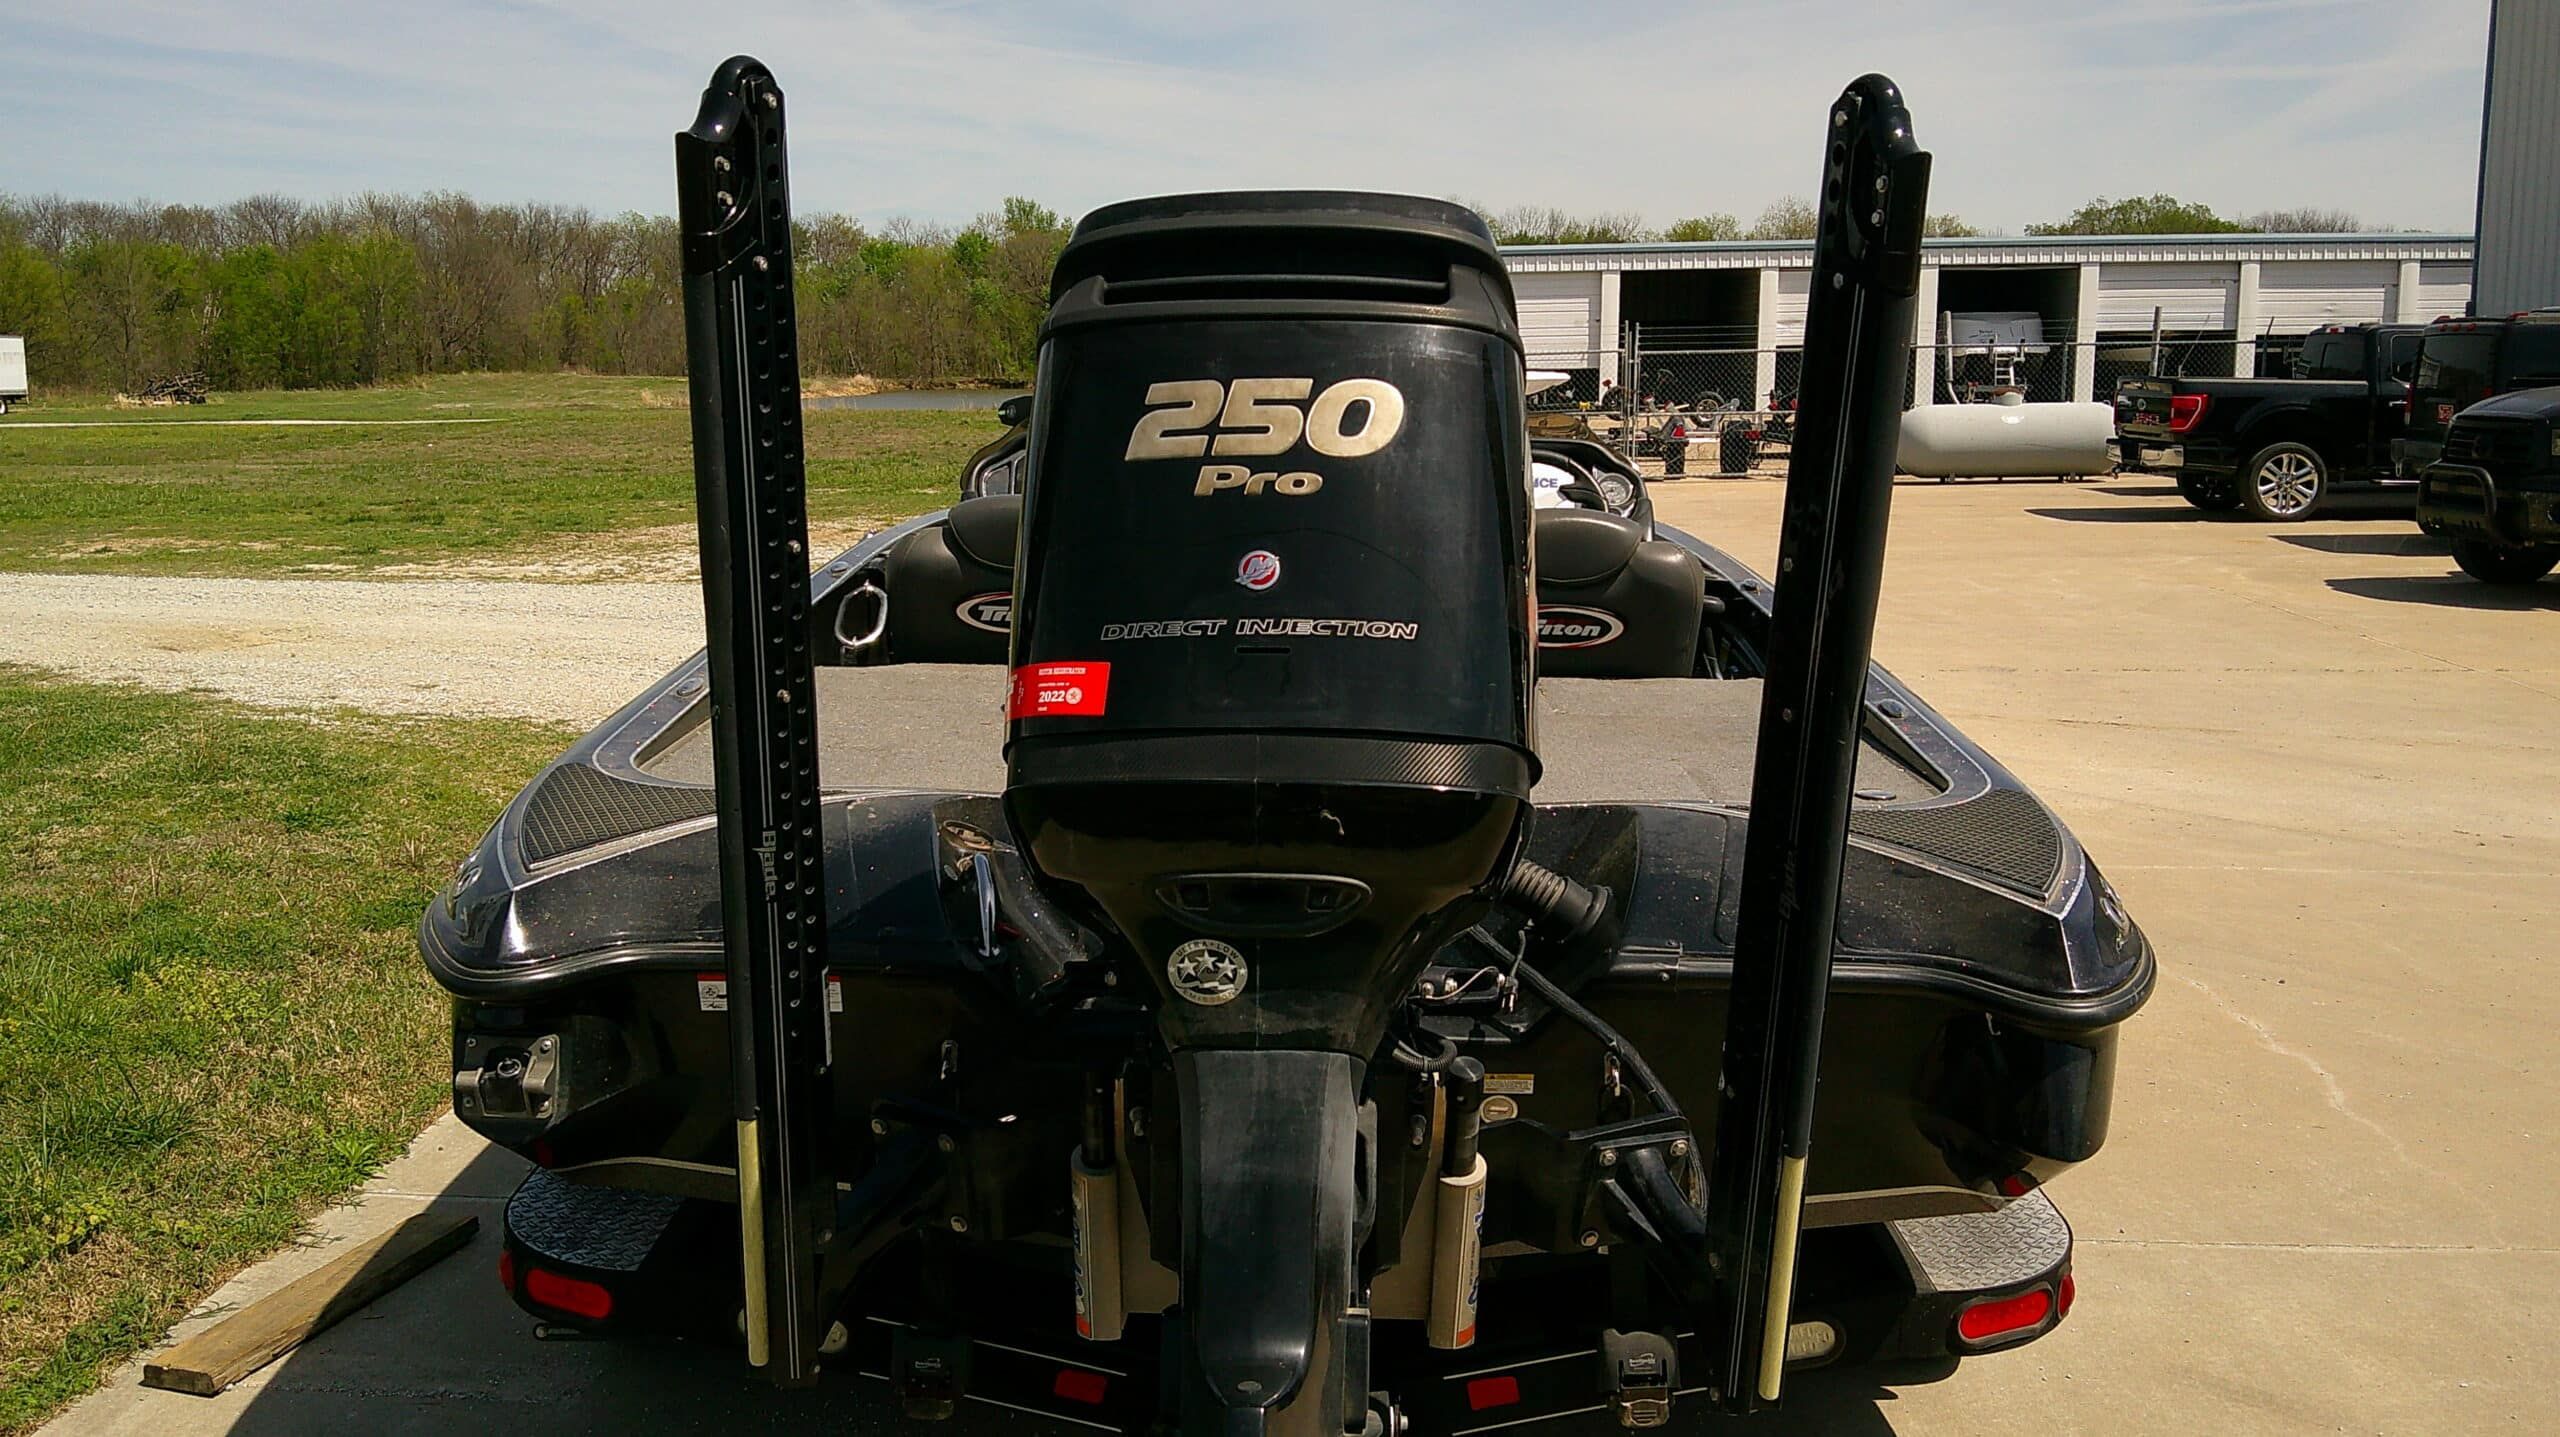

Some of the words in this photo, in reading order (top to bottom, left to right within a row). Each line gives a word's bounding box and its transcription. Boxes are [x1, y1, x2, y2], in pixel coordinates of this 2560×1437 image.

[1125, 378, 1405, 461] 250
[1194, 465, 1323, 496] Pro
[1100, 619, 1228, 640] DIRECT
[1235, 618, 1418, 640] INJECTION
[1038, 690, 1066, 703] 2022
